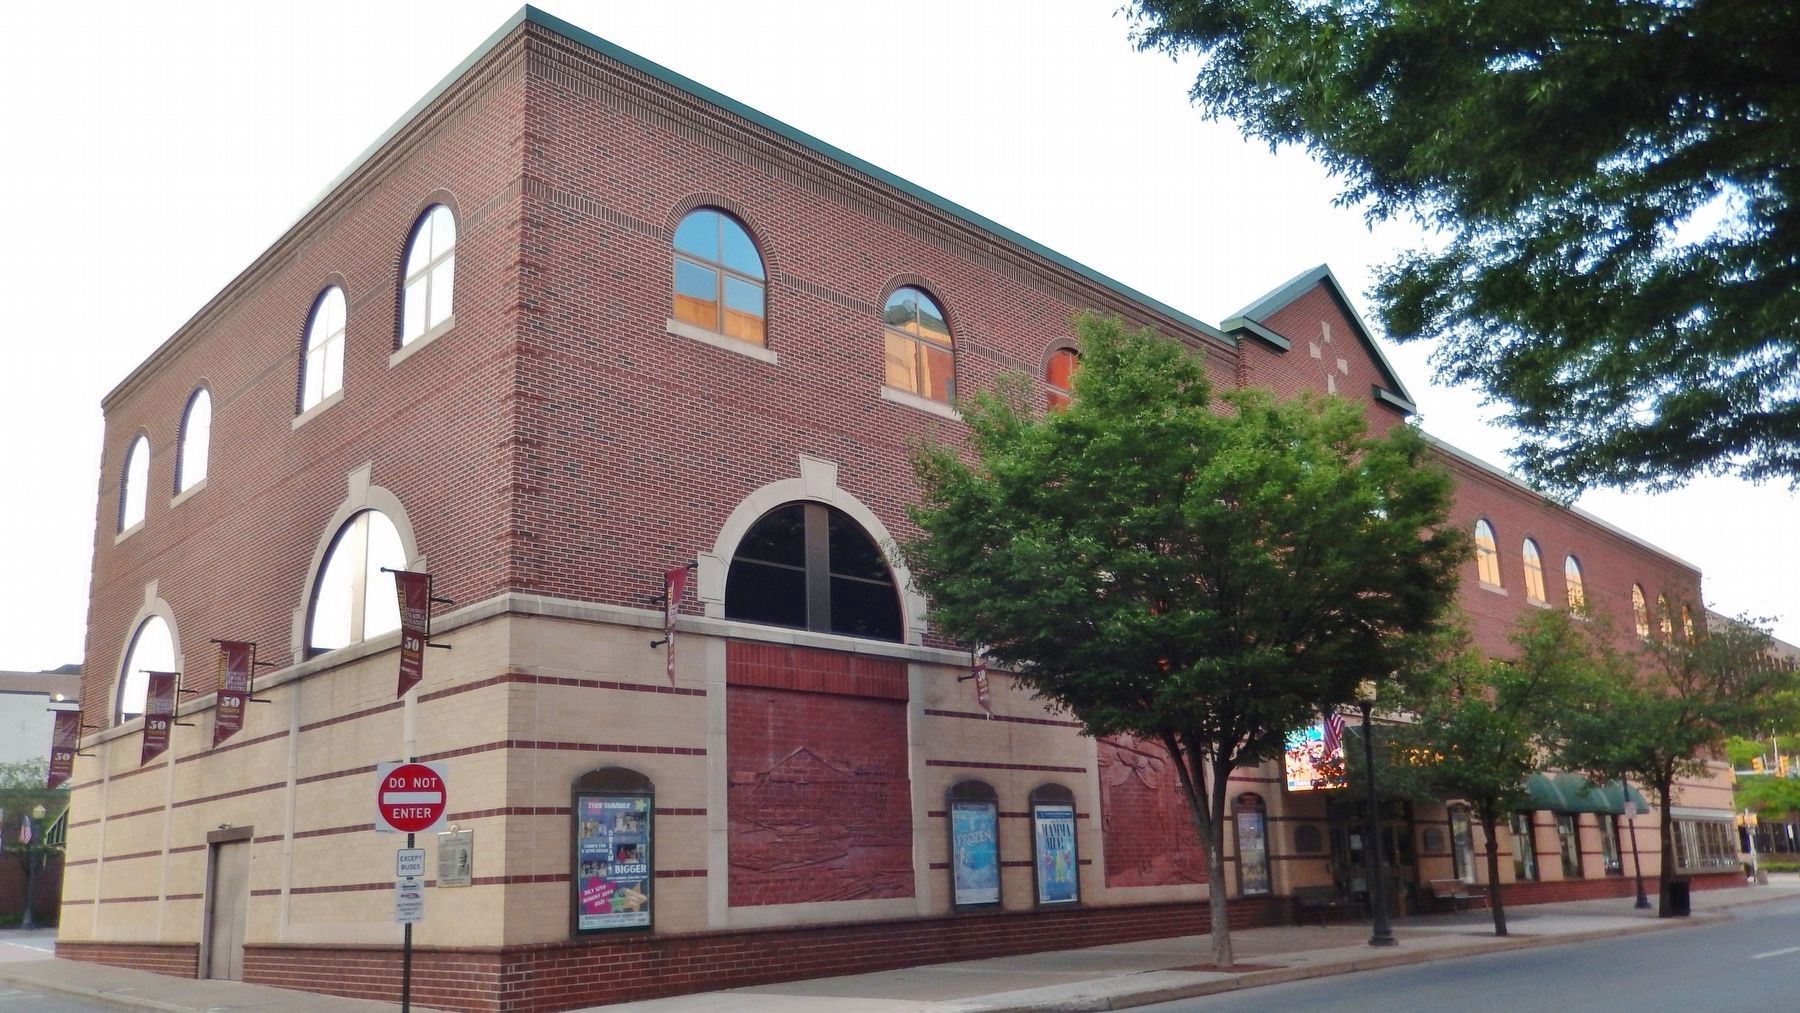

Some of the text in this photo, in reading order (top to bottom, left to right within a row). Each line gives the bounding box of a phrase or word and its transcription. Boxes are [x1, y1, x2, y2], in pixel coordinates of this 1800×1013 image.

[405, 637, 419, 651] 50
[221, 697, 240, 707] 50
[149, 720, 166, 730] 50
[55, 753, 70, 761] 50
[389, 777, 437, 788] DO NOT
[392, 807, 432, 819] ENTER
[1041, 823, 1071, 837] MAMMA
[958, 830, 991, 846] FROZEN
[614, 864, 647, 874] BIGGER
